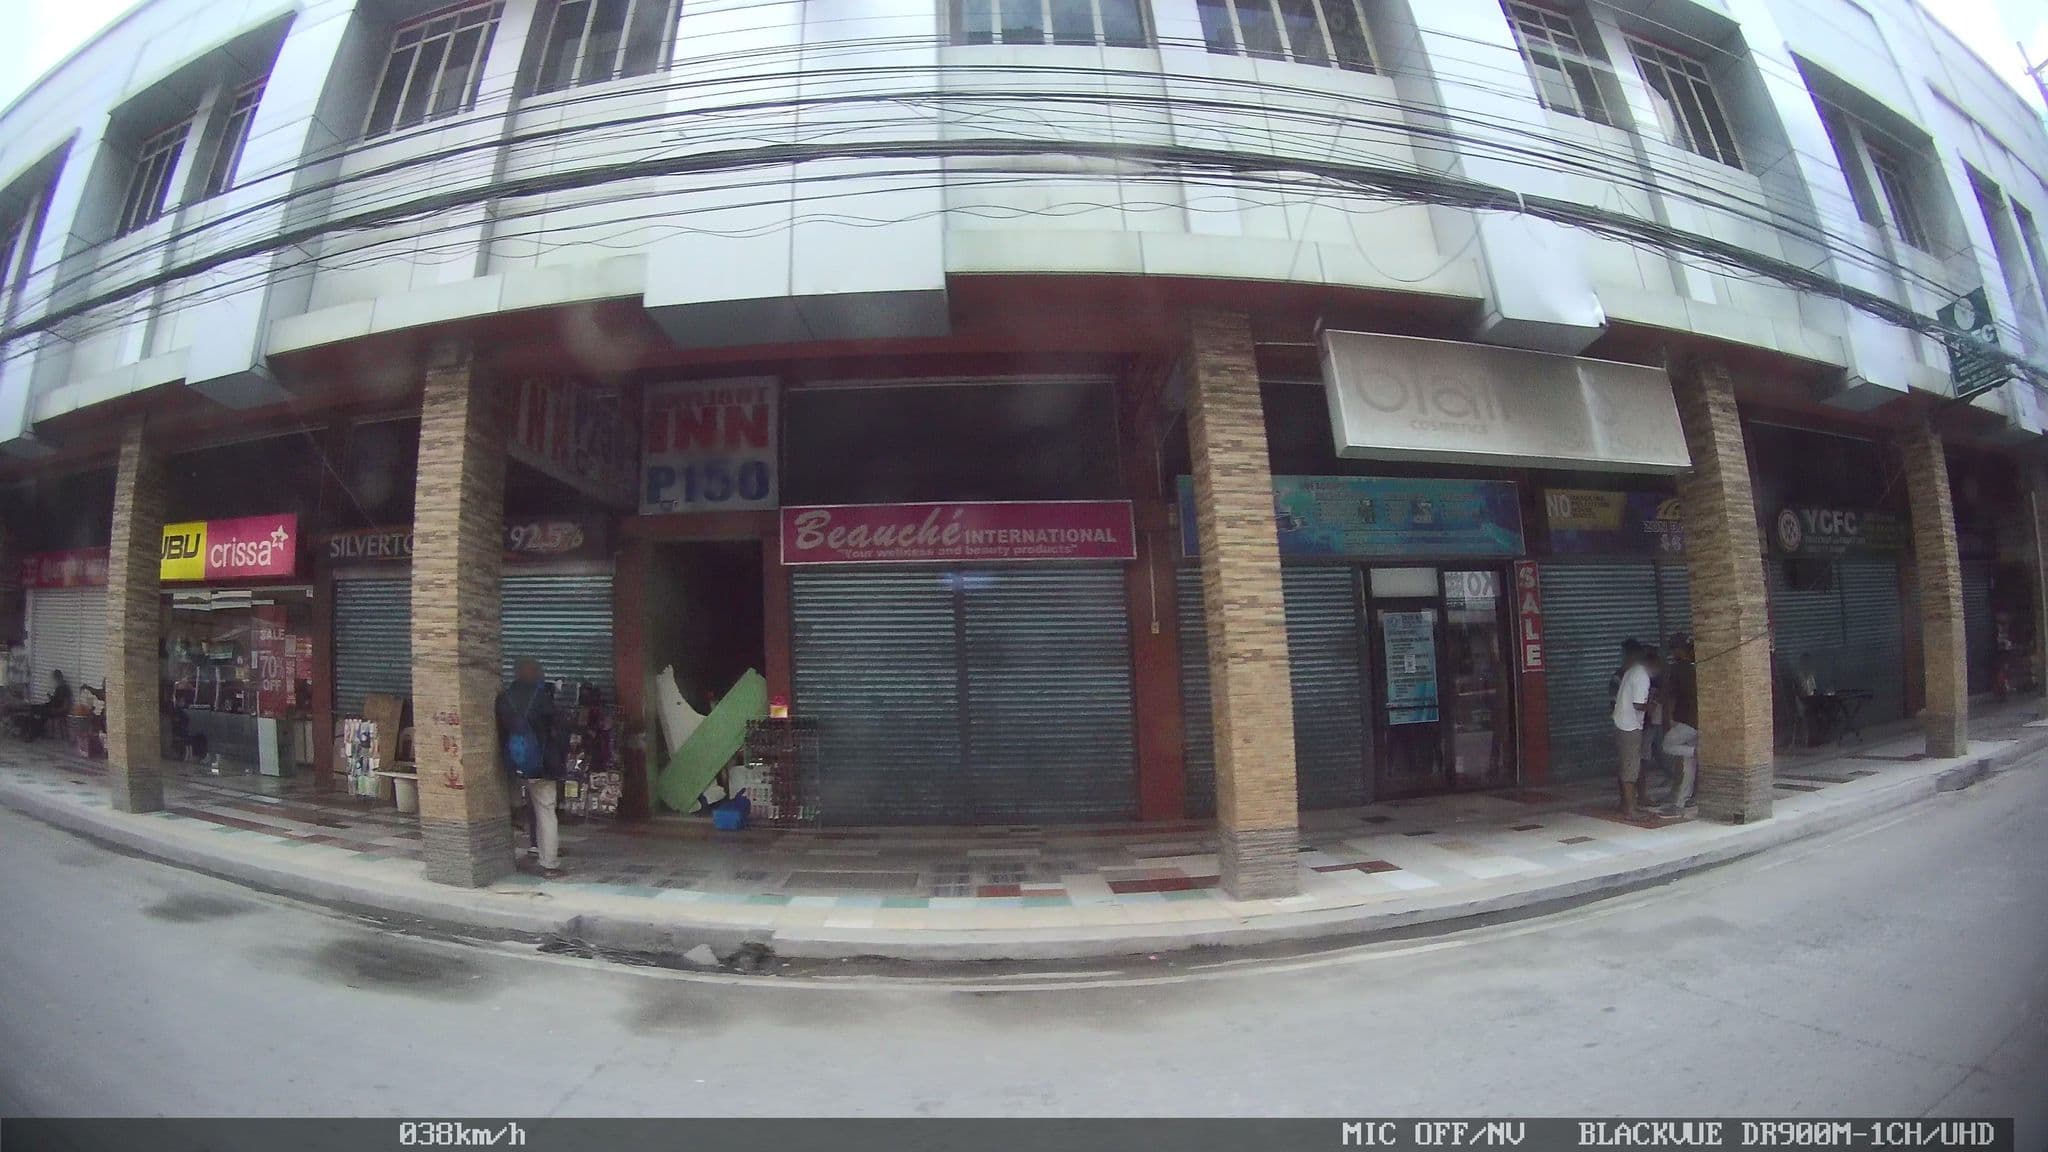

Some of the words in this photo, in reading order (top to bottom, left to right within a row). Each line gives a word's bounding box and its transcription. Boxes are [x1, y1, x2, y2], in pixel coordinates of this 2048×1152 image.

[648, 404, 769, 453] INN
[1411, 419, 1488, 433] COSMETICS
[647, 460, 769, 504] P150
[1545, 494, 1571, 518] NO
[794, 508, 963, 549] Beauché
[964, 527, 1117, 545] INTERNATIONAL
[1801, 509, 1857, 535] YCFC
[210, 538, 272, 568] crissa
[938, 546, 961, 556] and
[964, 546, 1010, 557] beauty
[1517, 566, 1542, 667] SALE
[260, 628, 285, 641] SALE
[263, 679, 282, 692] OFF
